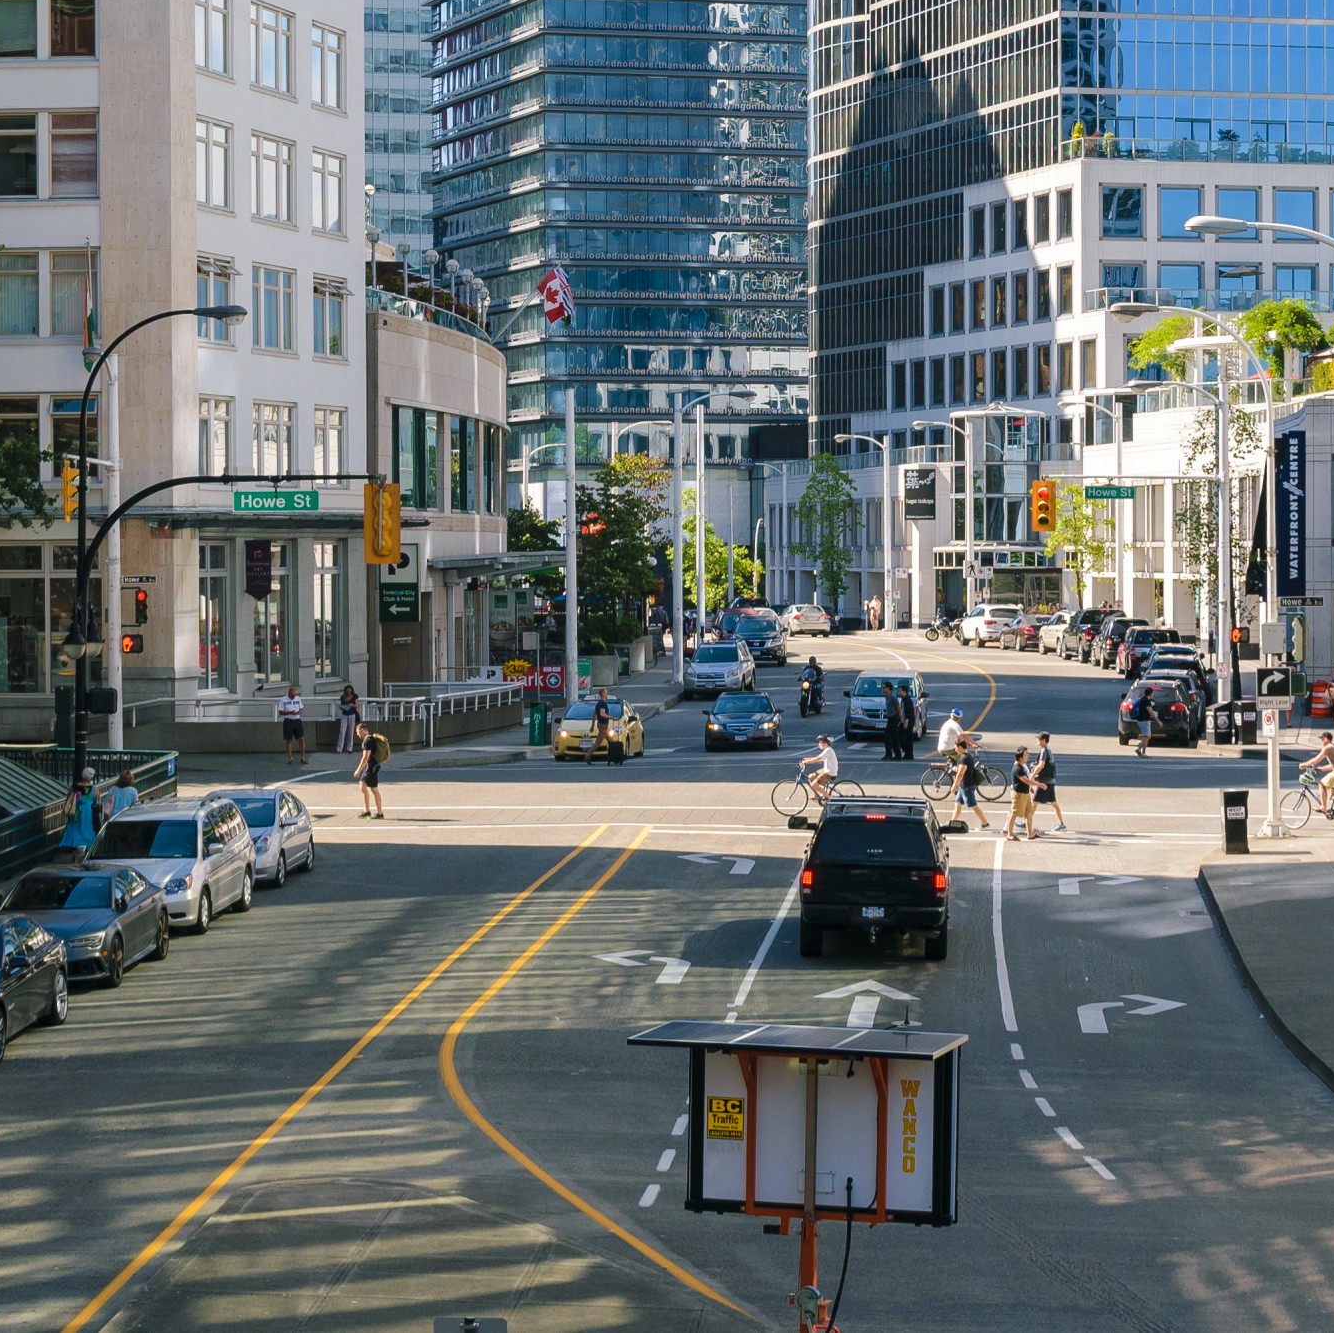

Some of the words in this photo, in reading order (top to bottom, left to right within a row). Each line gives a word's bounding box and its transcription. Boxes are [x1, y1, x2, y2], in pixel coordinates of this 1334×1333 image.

[1289, 438, 1298, 485] CENTRE
[1088, 487, 1117, 497] Howe
[1120, 487, 1132, 497] St
[241, 494, 286, 508] Howe
[293, 494, 311, 508] St
[1289, 494, 1298, 579] WATERFRONT
[1282, 598, 1302, 606] Howe
[712, 1099, 741, 1113] BC
[712, 1114, 739, 1124] Traffic
[900, 1079, 921, 1174] WANCO
